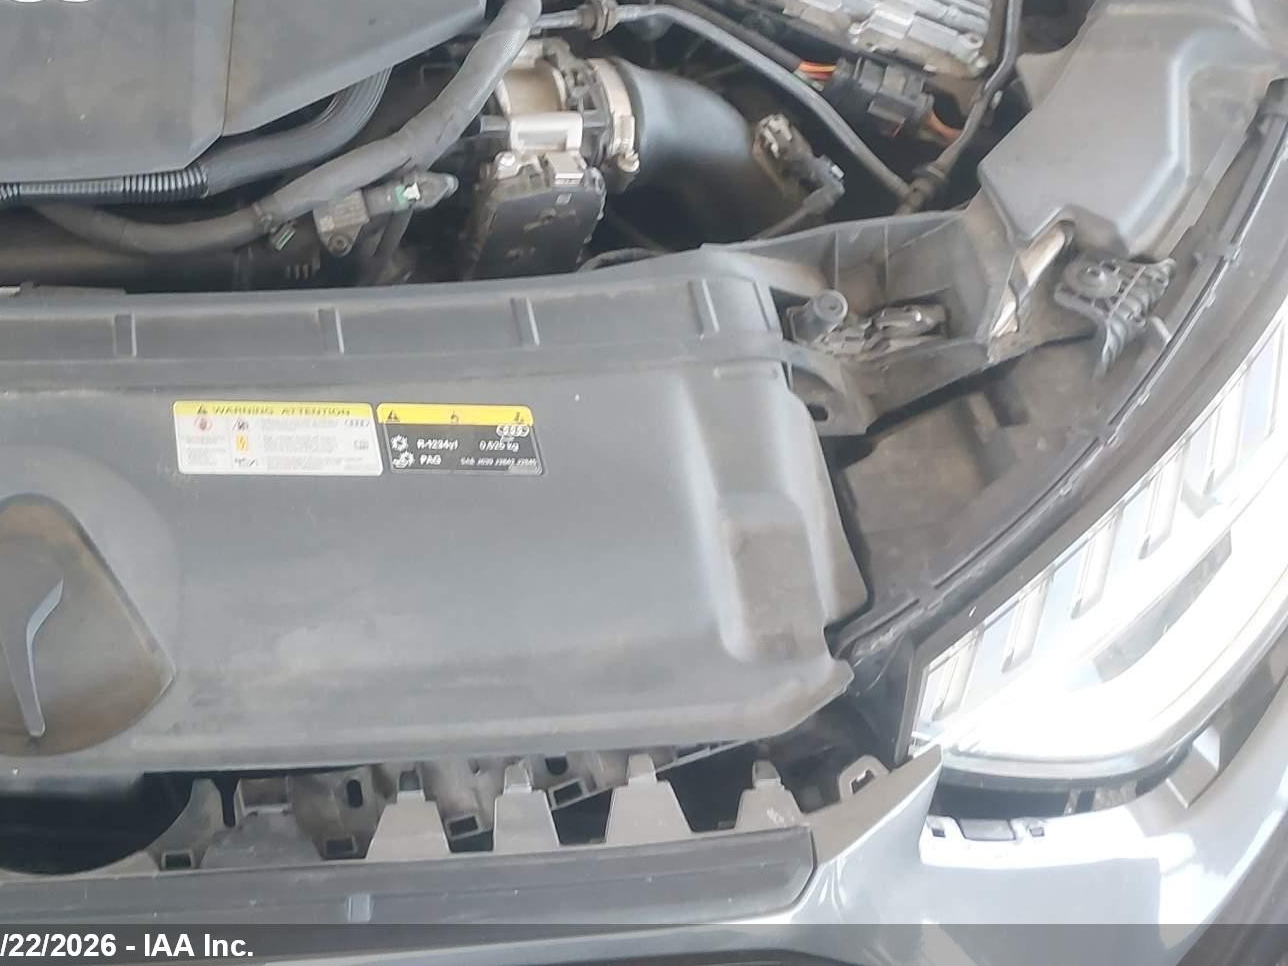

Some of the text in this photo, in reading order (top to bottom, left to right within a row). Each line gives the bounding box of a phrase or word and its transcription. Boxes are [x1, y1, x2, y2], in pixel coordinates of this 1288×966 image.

[214, 406, 351, 417] WARNING ATTENTION
[419, 454, 442, 466] PAG
